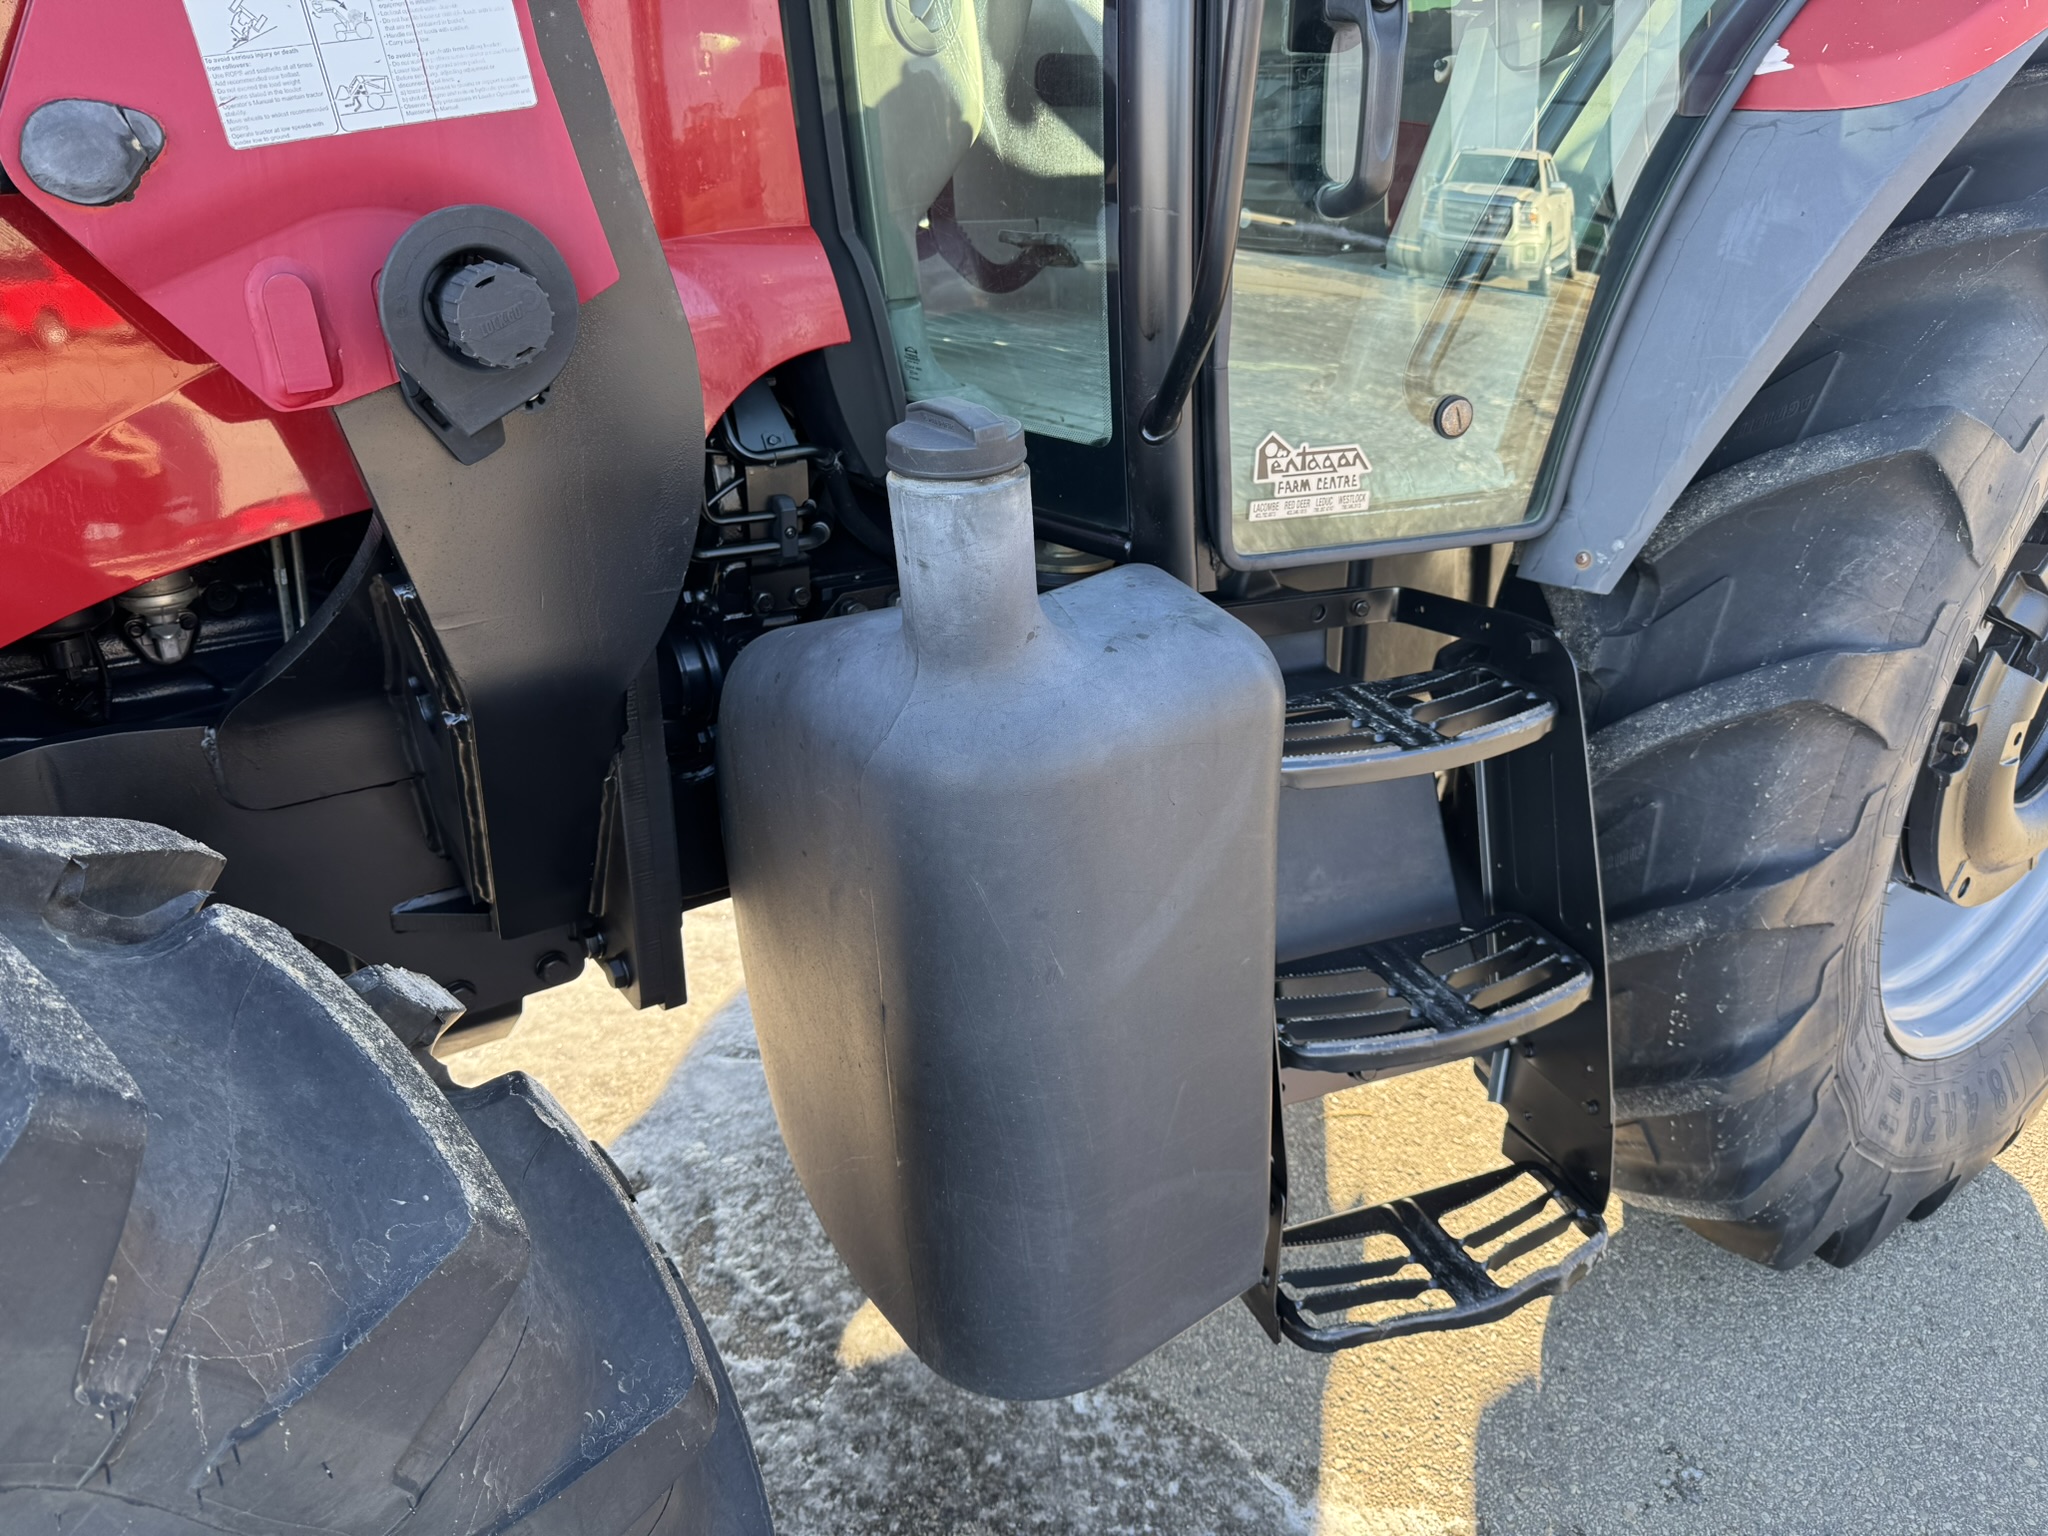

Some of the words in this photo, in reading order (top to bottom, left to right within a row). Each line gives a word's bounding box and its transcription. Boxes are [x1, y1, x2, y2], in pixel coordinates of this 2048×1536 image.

[252, 98, 274, 106] Manual
[1257, 435, 1369, 480] Pentagon
[1278, 479, 1311, 494] FARM
[1316, 474, 1358, 491] CENTRE
[1315, 497, 1334, 507] LEDUC
[1338, 493, 1367, 504] WESTLOCK
